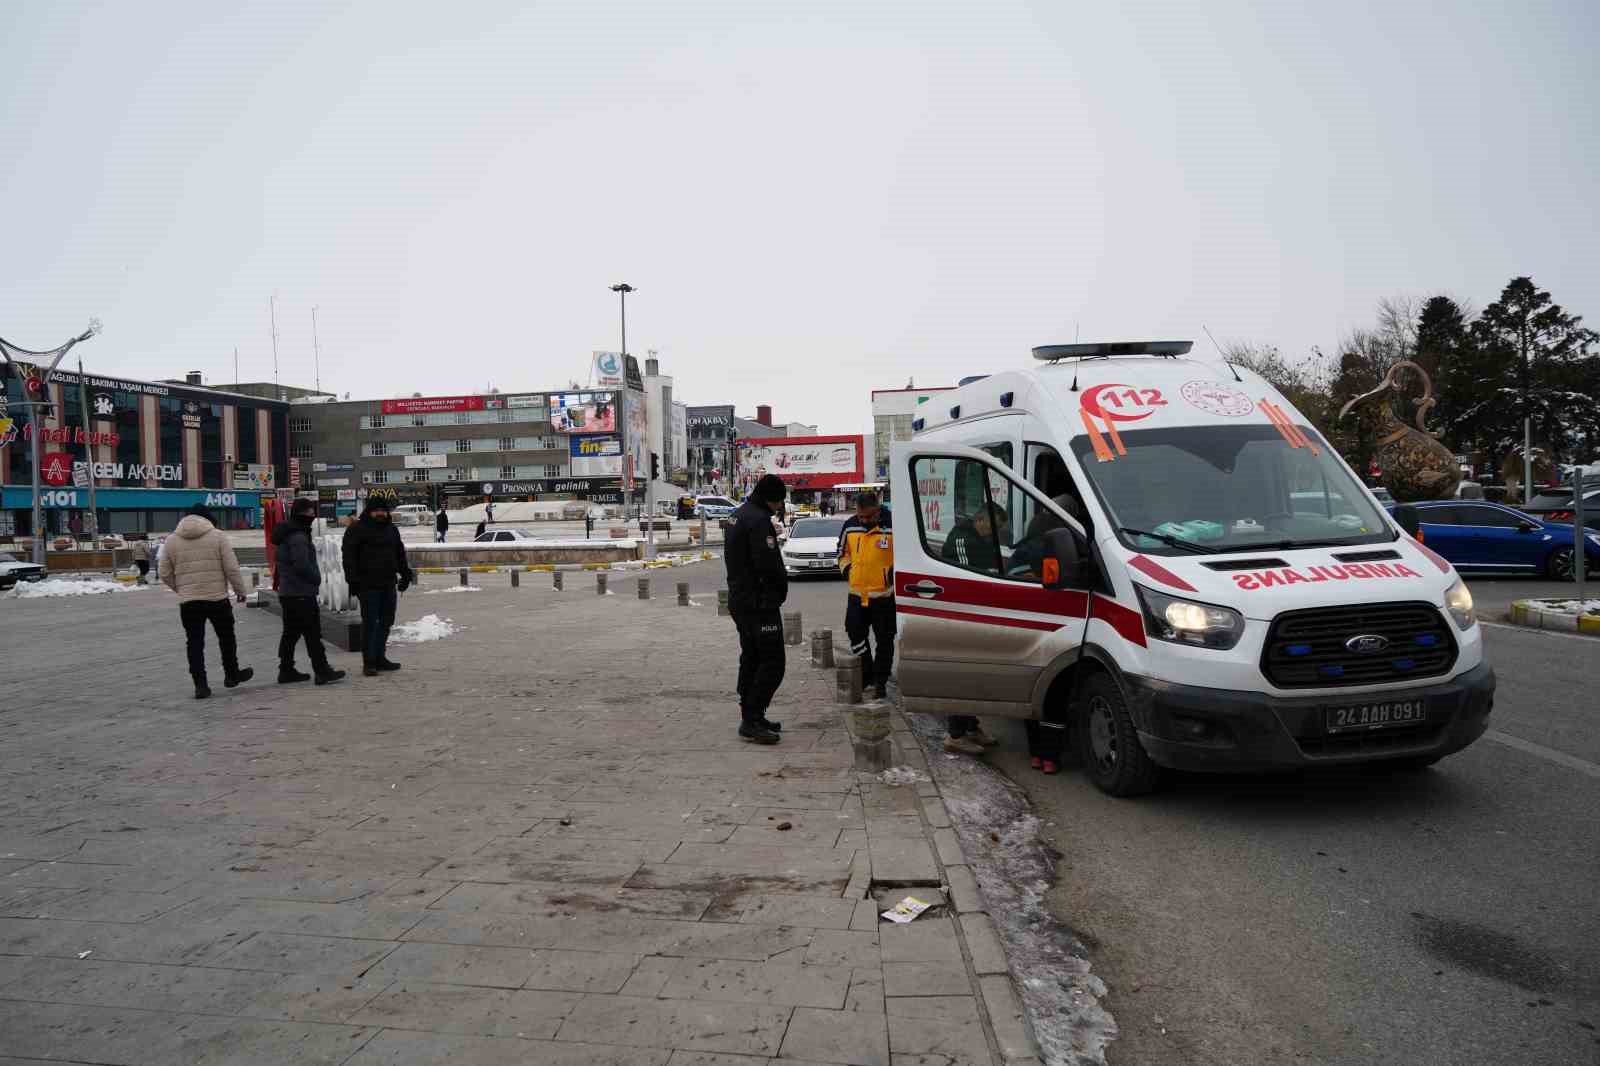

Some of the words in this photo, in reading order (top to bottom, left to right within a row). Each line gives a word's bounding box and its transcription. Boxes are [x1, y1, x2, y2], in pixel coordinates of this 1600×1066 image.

[51, 372, 79, 384] AĞLIKLI
[91, 378, 118, 389] BAKIMLI
[119, 382, 142, 393] YAŞAM
[1103, 388, 1168, 408] 112
[128, 463, 183, 481] AKADEMİ
[369, 487, 396, 499] ASYA
[502, 482, 543, 494] PRONOVA
[555, 481, 590, 492] gelinlik
[1393, 702, 1420, 720] 091
